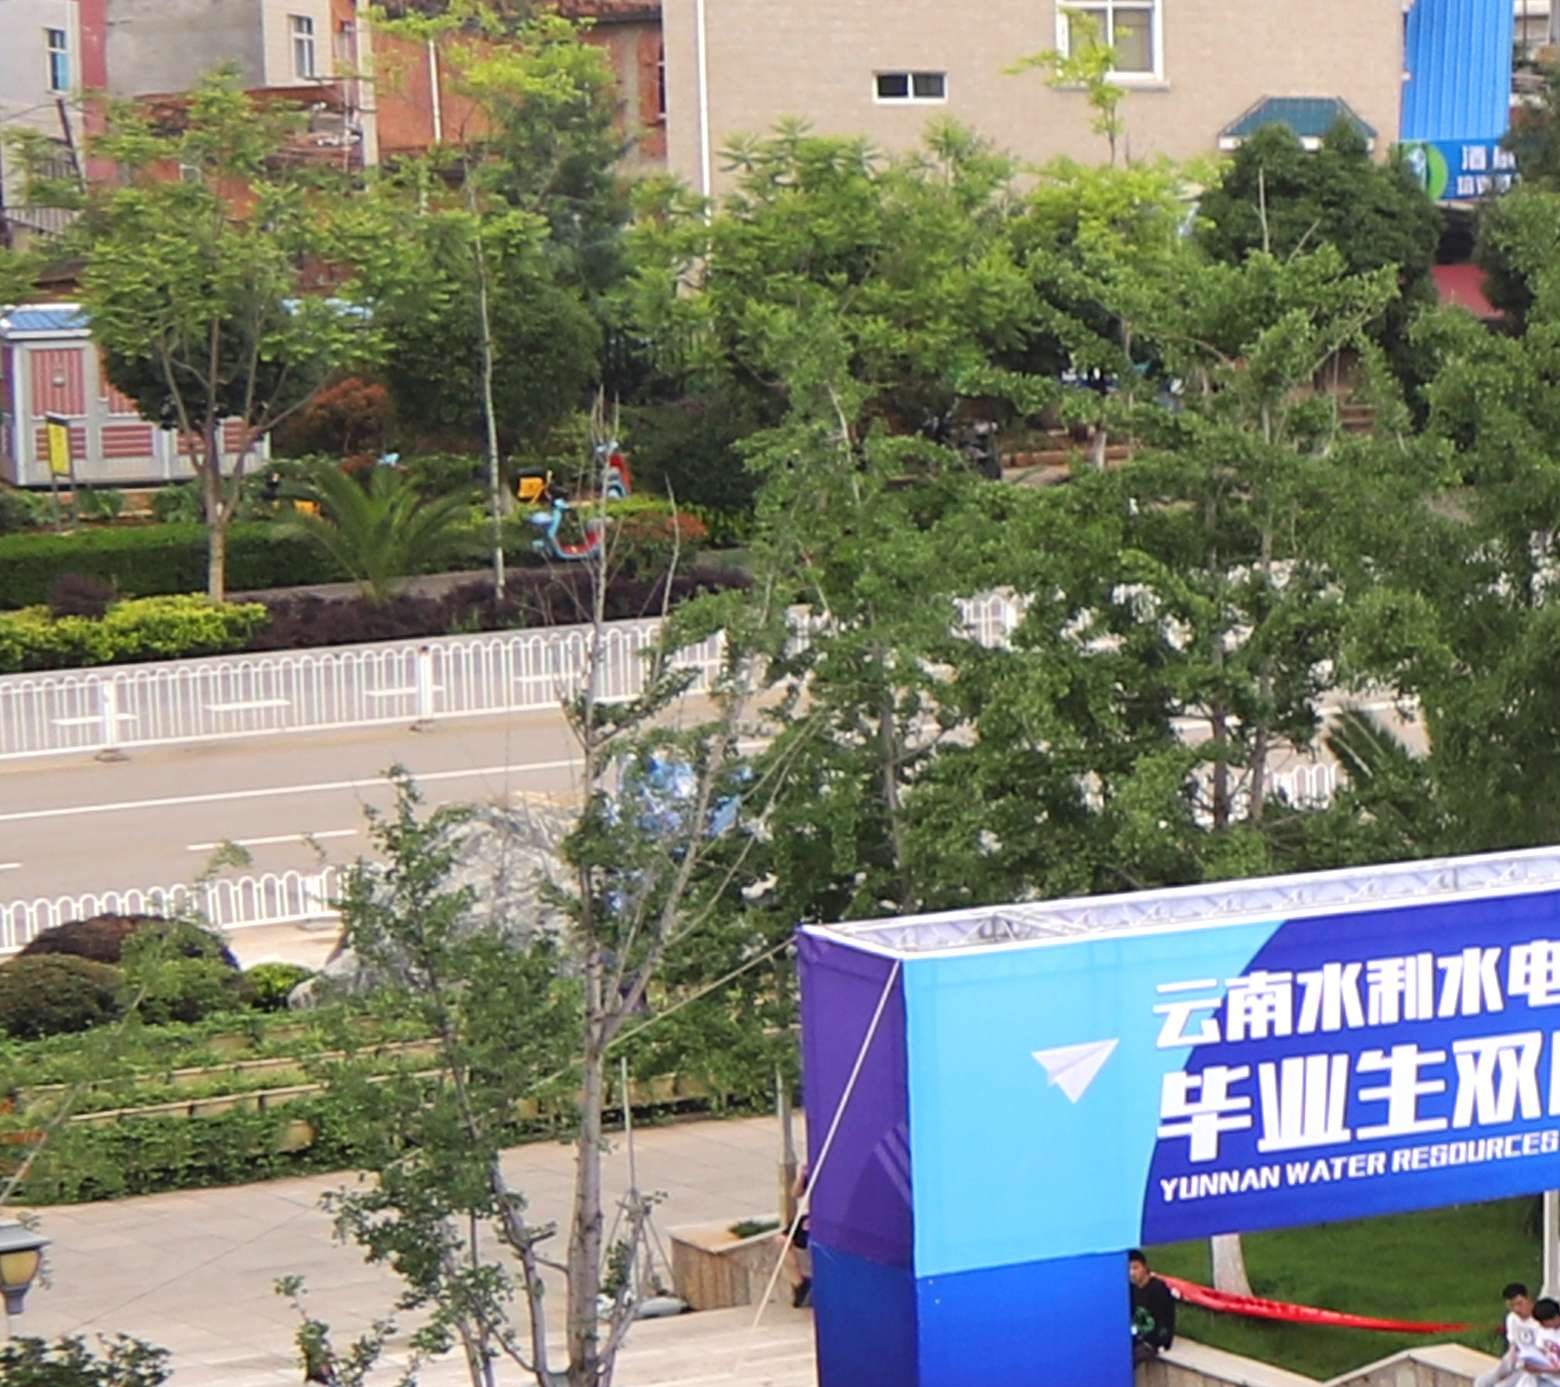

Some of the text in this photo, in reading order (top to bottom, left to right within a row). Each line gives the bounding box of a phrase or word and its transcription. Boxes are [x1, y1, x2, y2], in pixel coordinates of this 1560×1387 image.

[1161, 1166, 1281, 1202] YUNNAN
[1286, 1152, 1385, 1185] WATER
[1393, 1130, 1559, 1173] RESOURCES
